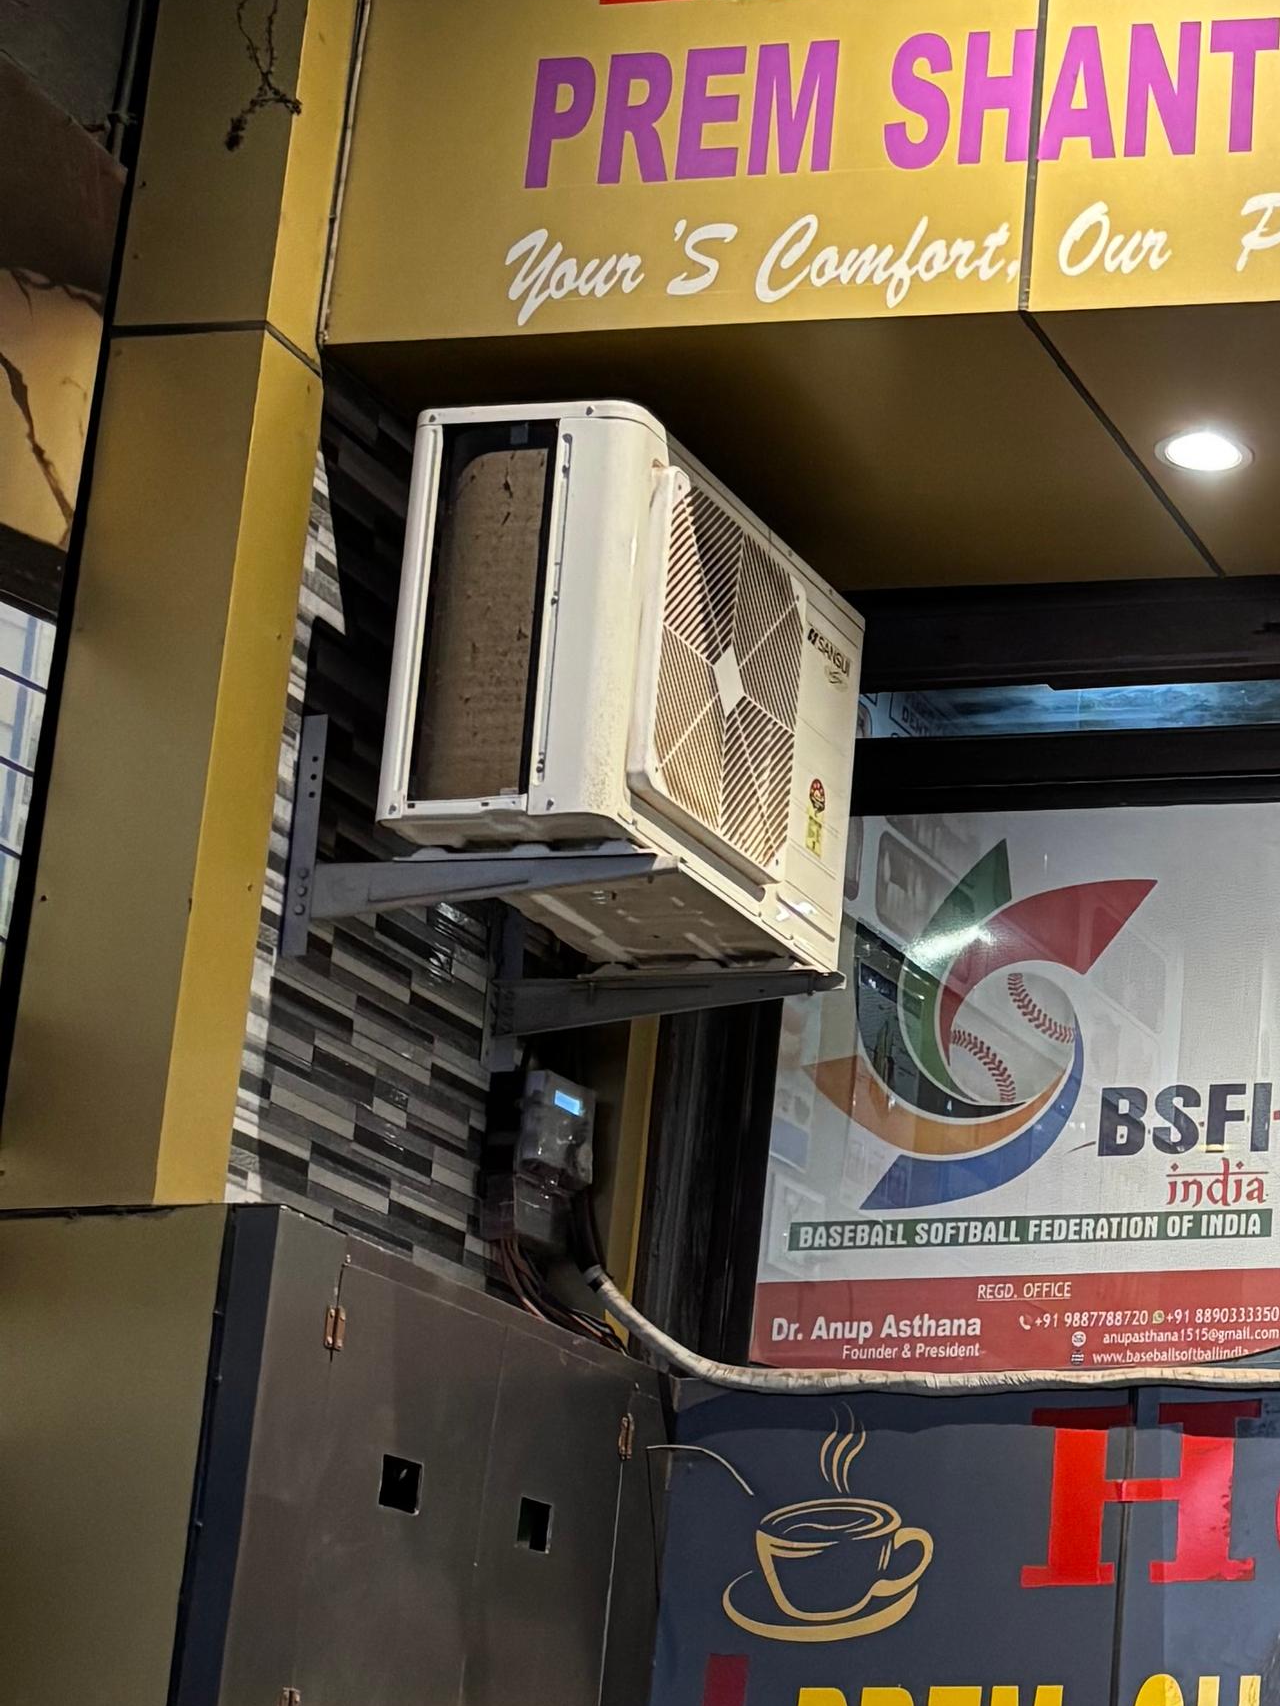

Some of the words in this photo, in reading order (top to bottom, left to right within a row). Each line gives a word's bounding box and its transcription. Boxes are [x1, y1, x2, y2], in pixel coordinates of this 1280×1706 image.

[525, 38, 840, 188] PREM
[505, 230, 643, 325] Your
[1058, 200, 1171, 276] Our
[1166, 1159, 1268, 1208] india
[799, 1220, 907, 1249] BASEBALL
[915, 1217, 1021, 1244] SOFTBALL
[1028, 1215, 1160, 1241] FEDERATION
[1167, 1215, 1194, 1237] OF
[1200, 1213, 1261, 1236] INDIA
[977, 1283, 1017, 1299] REGD.
[1024, 1282, 1071, 1298] OFFICE
[771, 1317, 803, 1341] Dr.
[811, 1316, 873, 1345] Anup
[880, 1313, 981, 1340] Asthana
[1034, 1313, 1059, 1330] +91
[1064, 1310, 1148, 1329] 9887788720
[1166, 1309, 1190, 1325] +91
[1195, 1306, 1280, 1324] 8890333350
[842, 1344, 897, 1360] Founder
[915, 1342, 980, 1358] President
[1103, 1326, 1279, 1347] anupasthana1515@gmail.com
